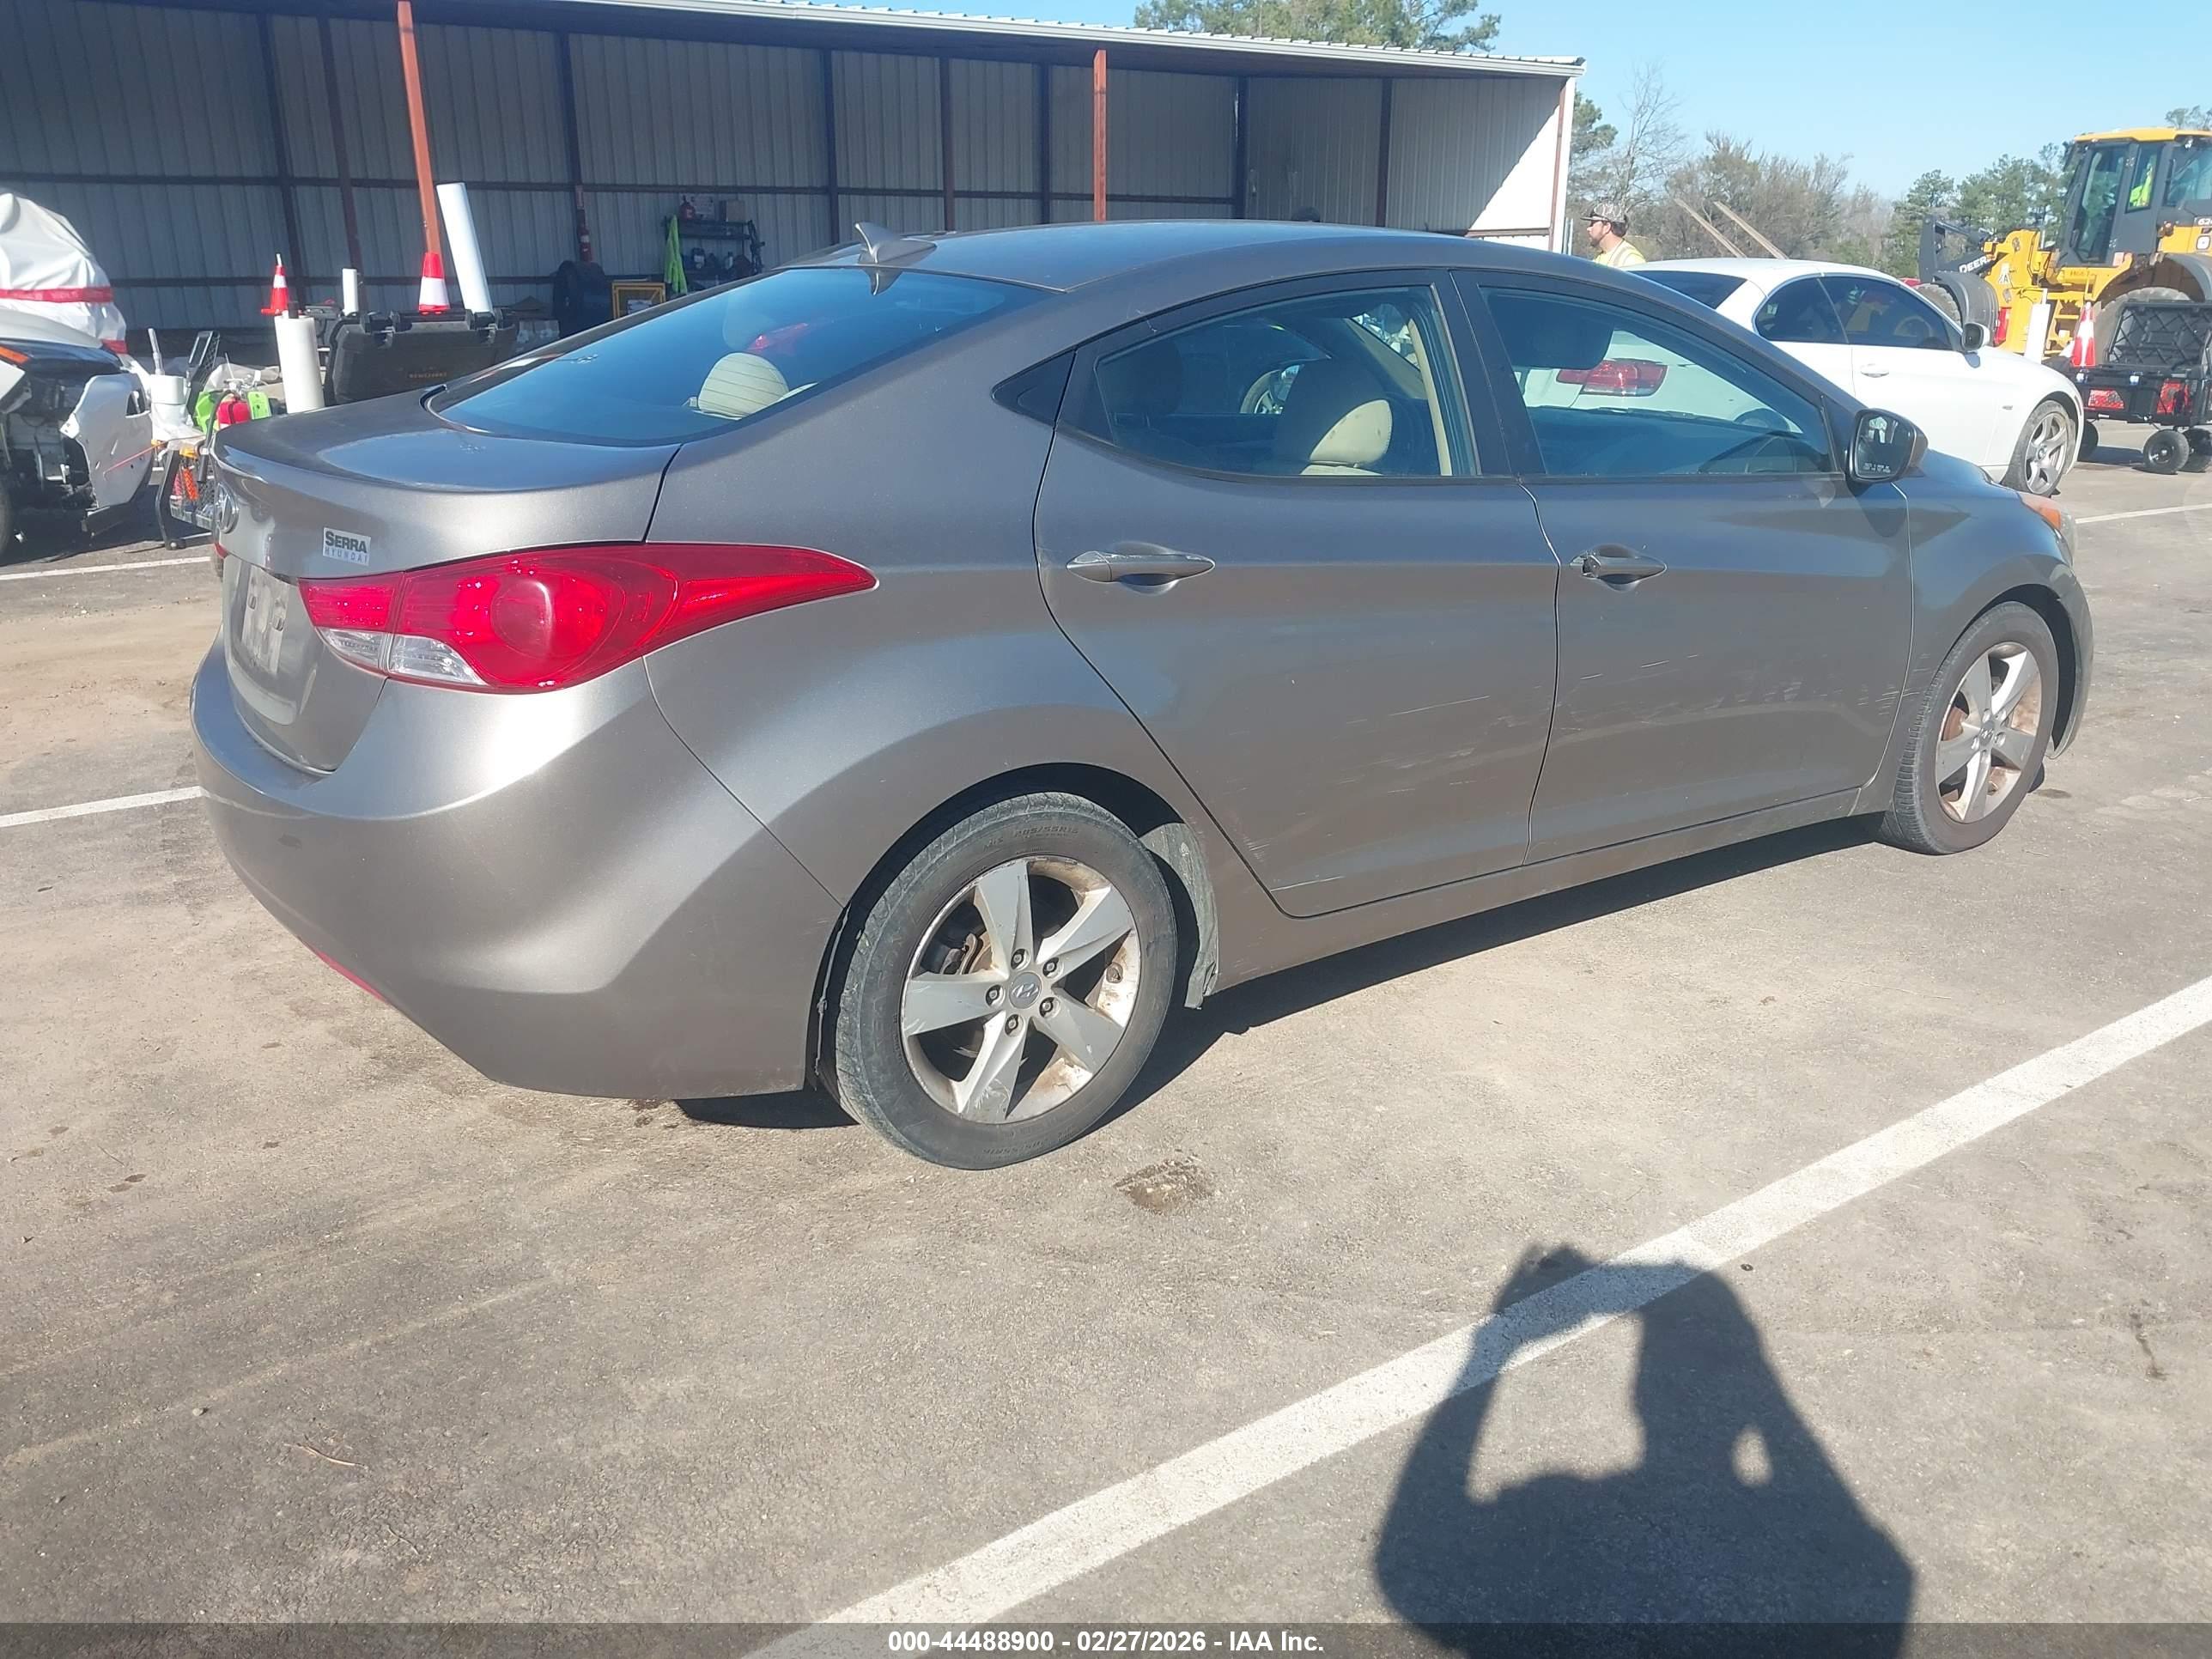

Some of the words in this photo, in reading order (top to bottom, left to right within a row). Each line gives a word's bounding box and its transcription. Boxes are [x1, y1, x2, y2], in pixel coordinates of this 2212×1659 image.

[2198, 217, 2212, 226] 62
[1959, 256, 1988, 273] DEER
[325, 531, 367, 554] SERRA
[325, 545, 368, 564] HYUNDAI
